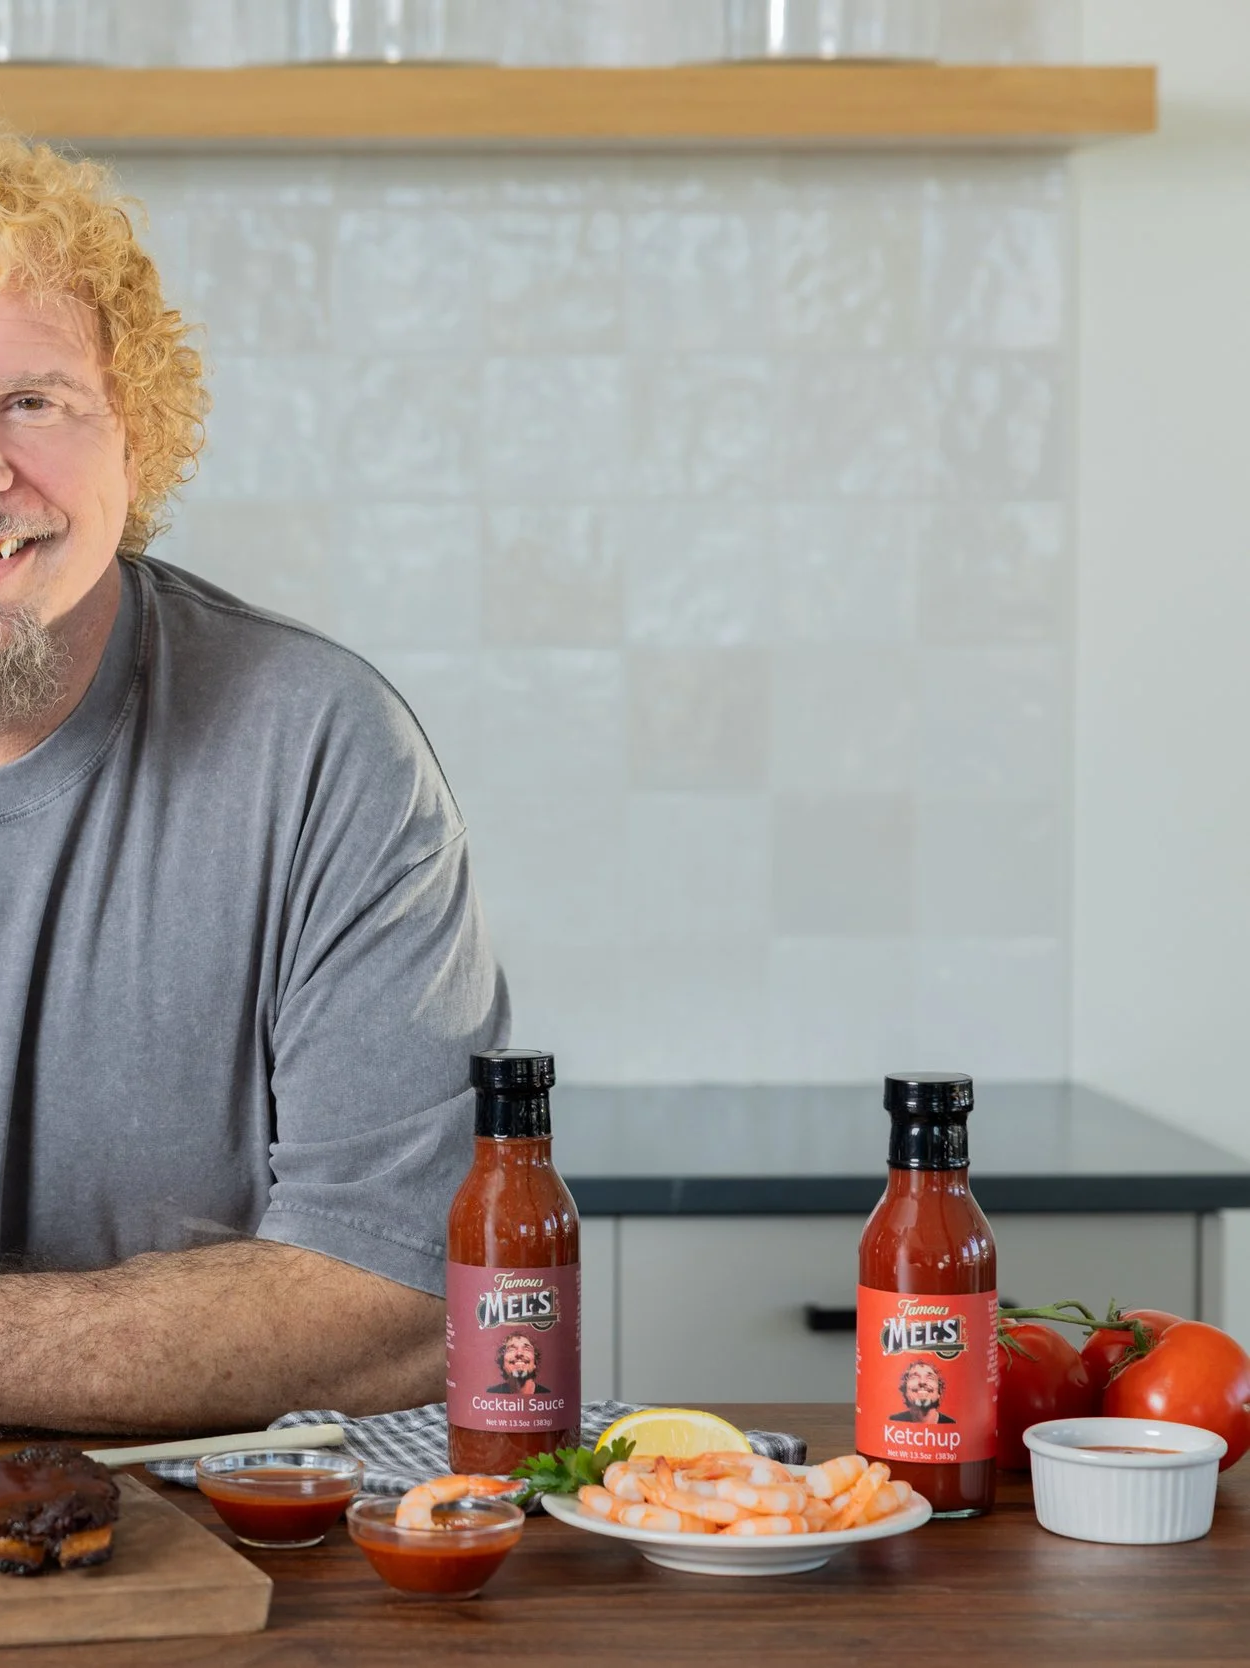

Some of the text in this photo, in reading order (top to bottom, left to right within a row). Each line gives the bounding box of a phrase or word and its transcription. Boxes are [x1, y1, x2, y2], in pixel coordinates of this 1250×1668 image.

[493, 1271, 544, 1292] Famous
[479, 1290, 551, 1329] MEL'S
[896, 1297, 949, 1318] Famous
[883, 1318, 957, 1355] MEL'S
[472, 1396, 565, 1412] Cocktail Sauce
[485, 1418, 497, 1427] Net
[498, 1419, 508, 1427] Wt
[509, 1419, 530, 1427] 13.5oz
[884, 1425, 961, 1450] Ketchup
[887, 1449, 899, 1459] Net
[899, 1451, 908, 1459] Wt
[909, 1452, 931, 1460] 13.5oz
